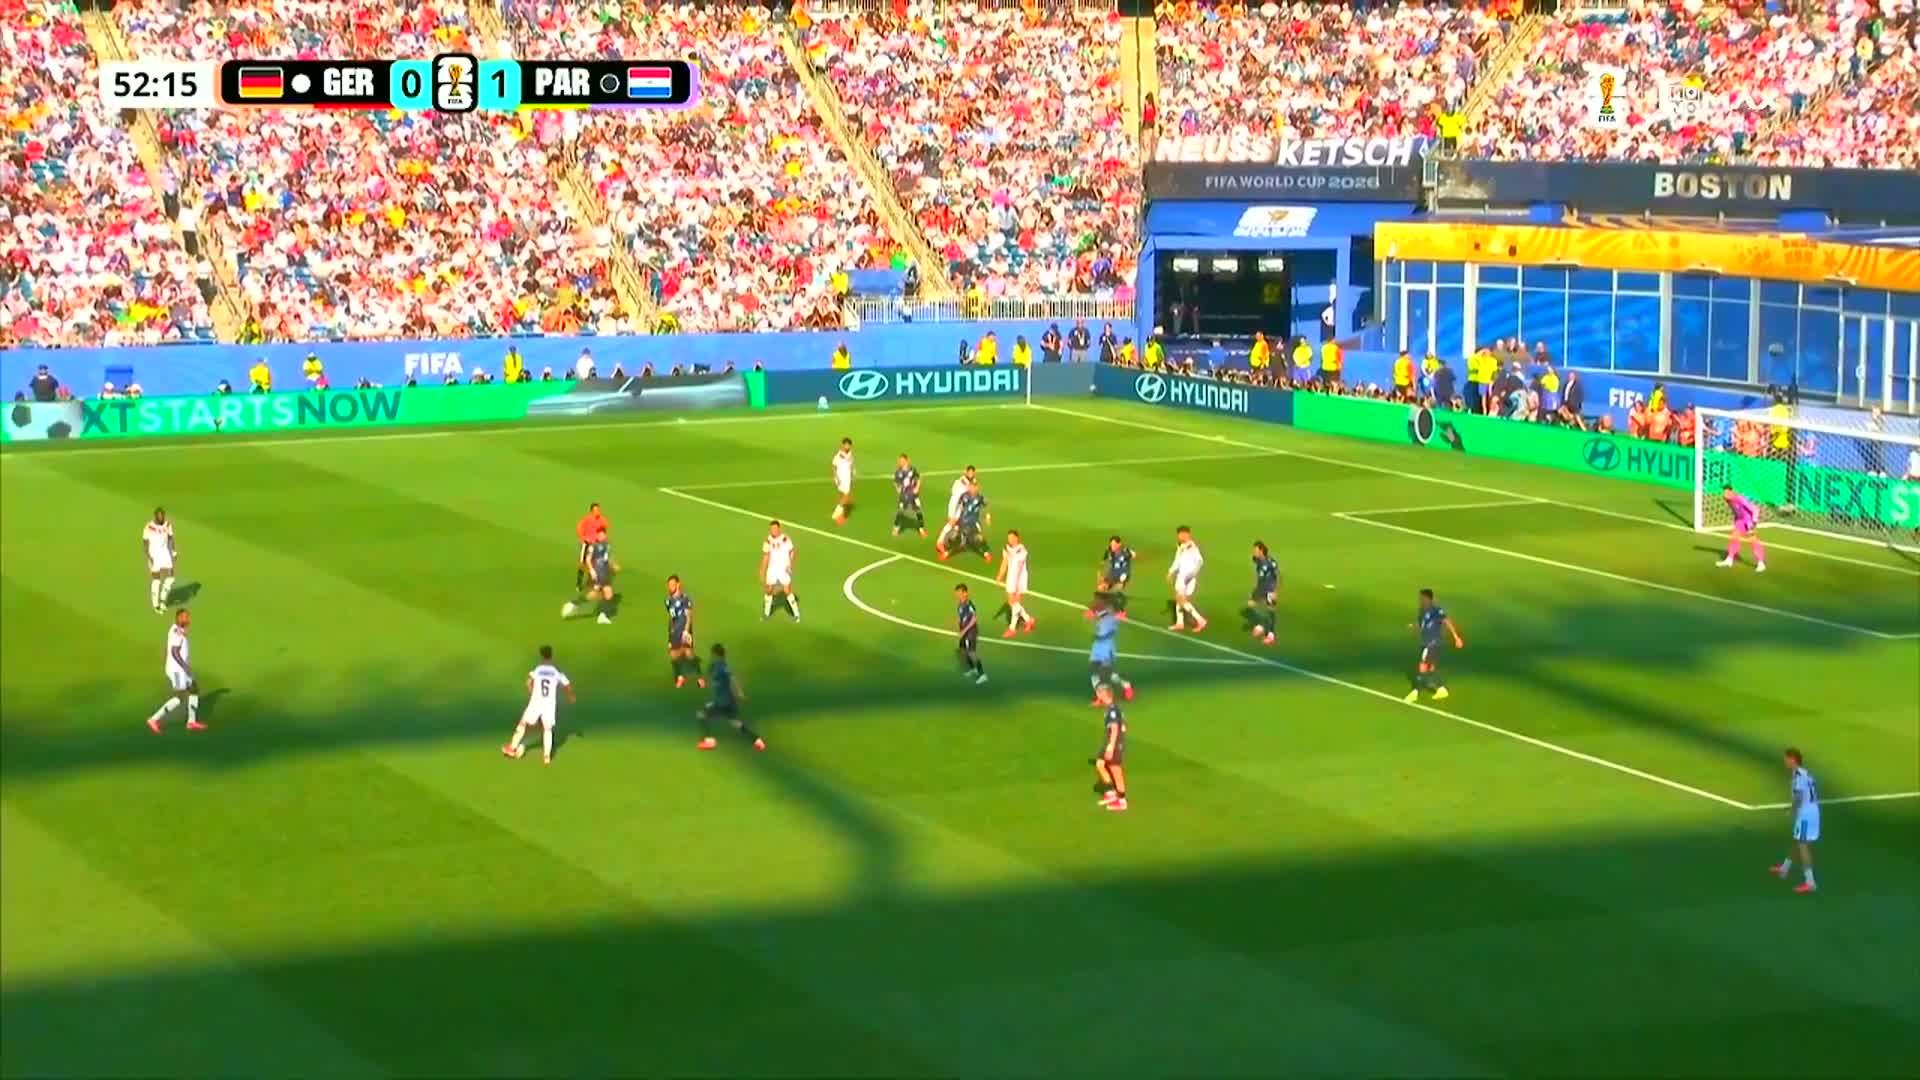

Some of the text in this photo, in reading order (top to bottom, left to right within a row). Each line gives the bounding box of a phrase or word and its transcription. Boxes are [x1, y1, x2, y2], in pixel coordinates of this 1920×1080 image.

[1277, 137, 1413, 166] KETSCH
[1205, 176, 1380, 188] FIFA WORLD CUP 2026
[1653, 171, 1793, 201] BOSTON
[404, 353, 463, 375] FIFA
[896, 369, 1019, 395] HYUNDAI
[1170, 379, 1248, 413] HYUNDAI
[139, 396, 294, 433] STARTS
[297, 391, 402, 424] NOW
[1799, 471, 1888, 519] NEXT
[541, 679, 550, 697] 6
